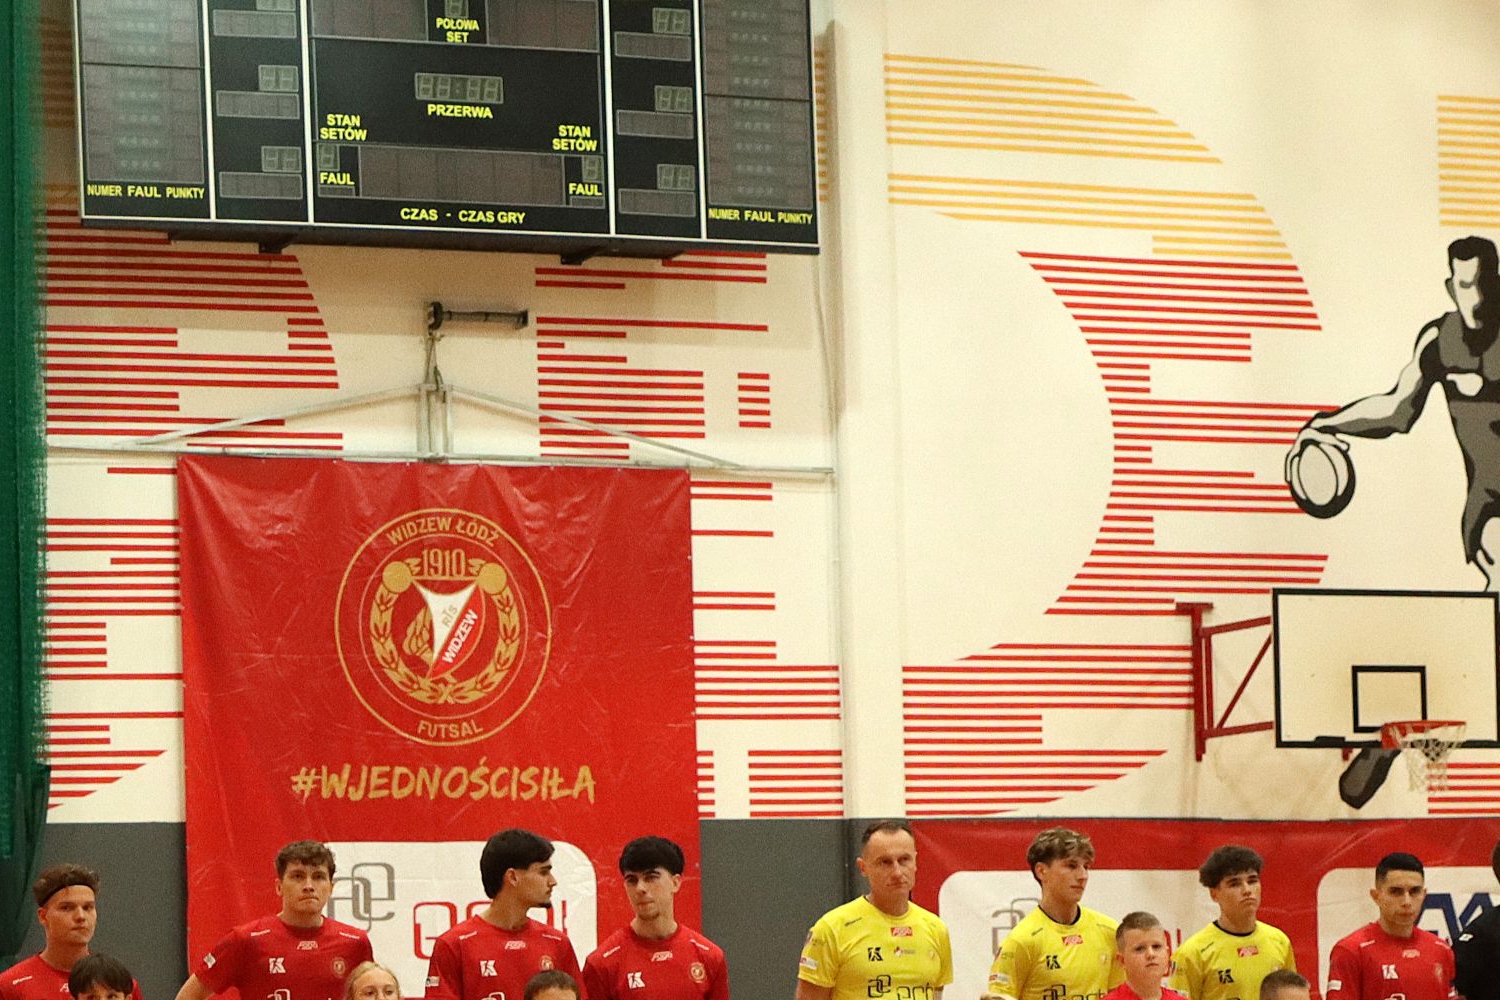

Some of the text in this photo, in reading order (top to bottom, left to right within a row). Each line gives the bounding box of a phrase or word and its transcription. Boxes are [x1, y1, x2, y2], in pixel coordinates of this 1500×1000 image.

[436, 18, 479, 31] POŁOWA
[446, 32, 469, 43] SET
[427, 104, 493, 119] PRZERWA
[327, 114, 360, 127] STAN
[320, 126, 367, 141] SETÓW
[558, 125, 591, 138] STAN
[552, 137, 597, 151] SETÓW
[320, 173, 355, 185] FAUL
[87, 184, 205, 199] NUMER FAUL PUNKTY
[569, 183, 602, 195] FAUL
[400, 208, 438, 220] CZAS
[458, 210, 494, 223] CZAS
[497, 211, 526, 224] GRY
[708, 207, 813, 224] NUMER FAUL PUNKTY
[386, 516, 500, 547] WIDZEW ŁÓDŹ
[421, 549, 466, 577] 1910
[443, 605, 458, 627] RTS
[442, 609, 479, 664] WIDZEW
[417, 719, 484, 739] FUTSAL
[290, 756, 596, 804] #WJEDNOŚCISIŁA
